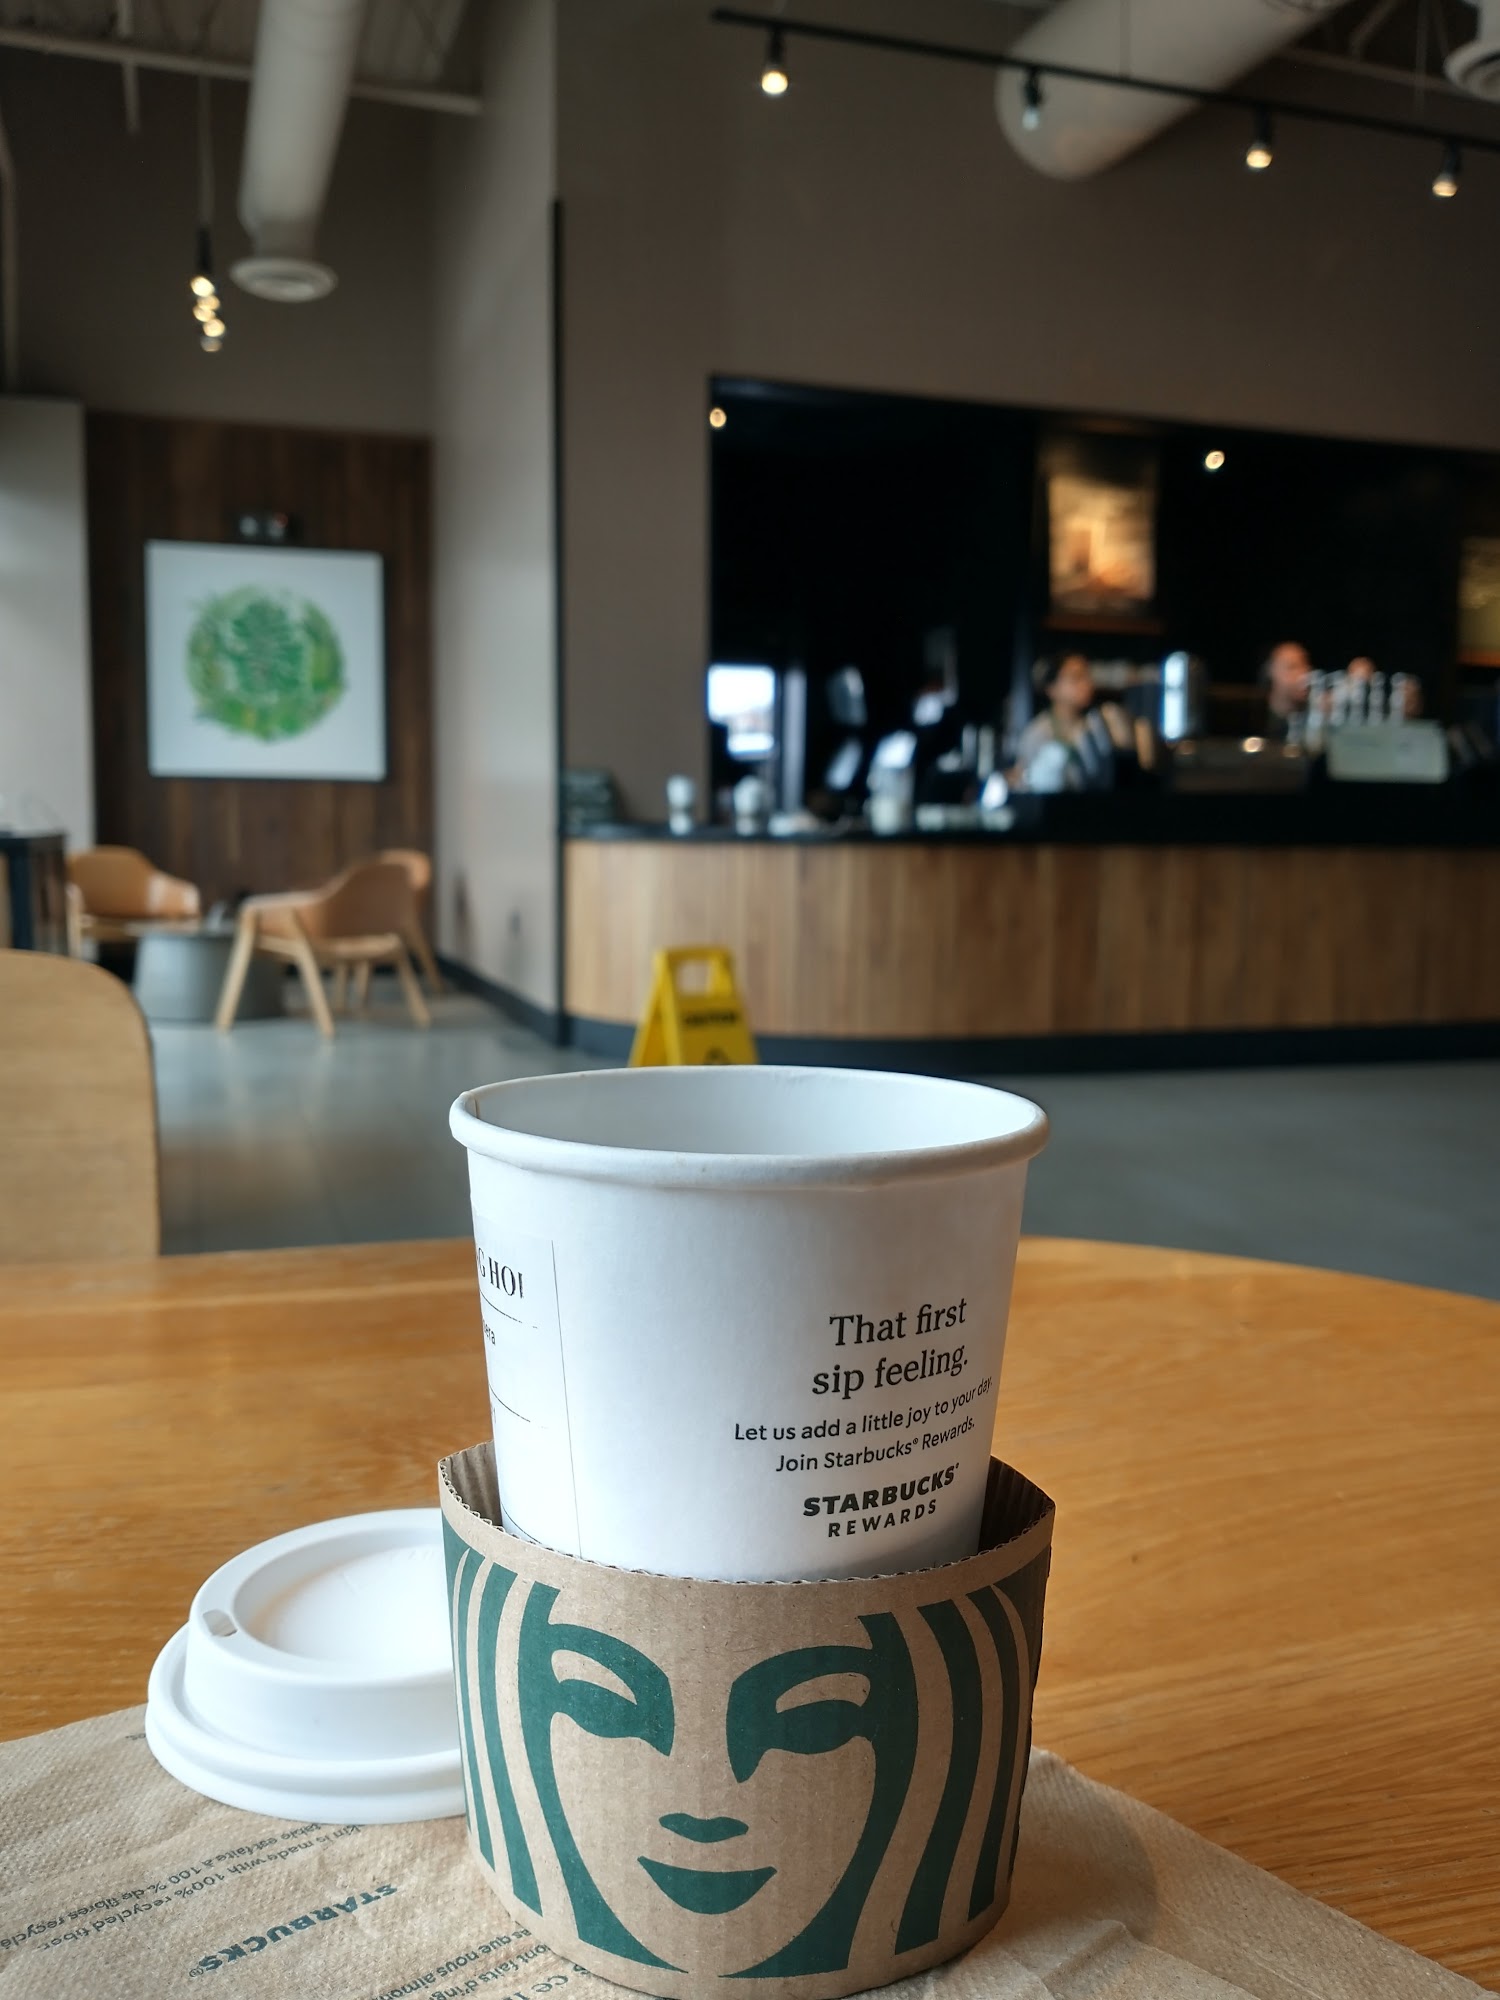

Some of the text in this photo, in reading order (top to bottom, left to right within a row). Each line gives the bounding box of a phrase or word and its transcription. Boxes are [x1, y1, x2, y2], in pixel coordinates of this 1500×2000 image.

[829, 1298, 967, 1346] That first
[812, 1345, 968, 1400] sip feeling.
[735, 1376, 993, 1441] Let us add a little joy to your day.
[776, 1454, 818, 1472] Join
[922, 1415, 975, 1450] Rewards.
[828, 1499, 937, 1538] REWARDS
[267, 1841, 314, 1861] made
[168, 1866, 201, 1884] 100
[227, 1857, 267, 1875] with
[174, 1873, 225, 1899] 100%
[67, 1897, 120, 1921] fibres
[92, 1895, 172, 1932] recycled
[478, 1935, 512, 1954] que
[436, 1951, 480, 1977] nous
[478, 1960, 519, 1983] faits
[371, 1973, 437, 2000] aimon
[429, 1980, 479, 2000] d'ing
